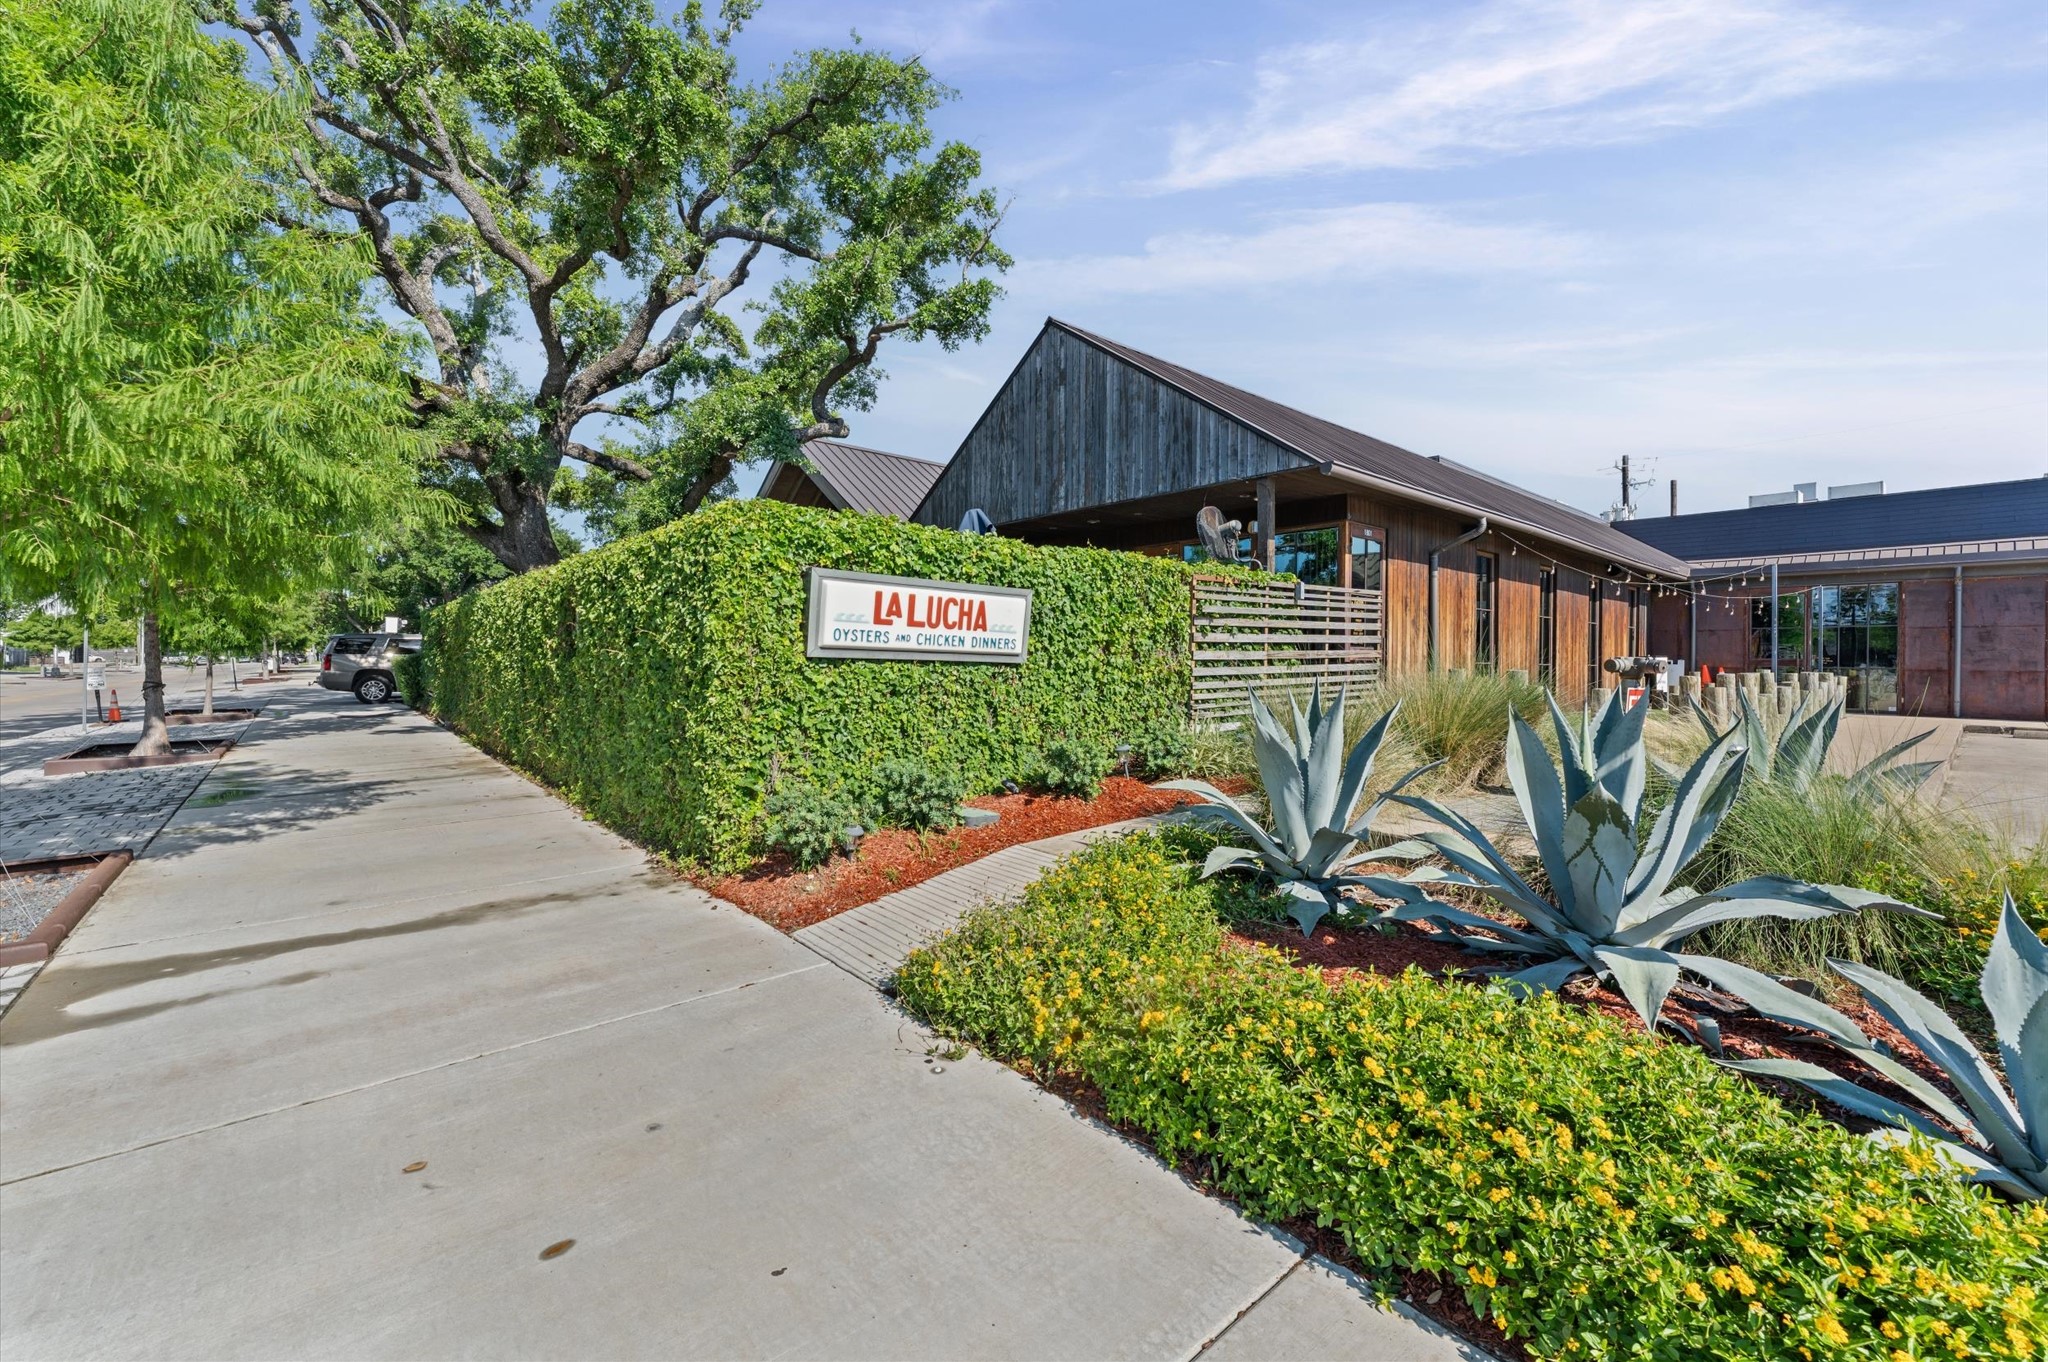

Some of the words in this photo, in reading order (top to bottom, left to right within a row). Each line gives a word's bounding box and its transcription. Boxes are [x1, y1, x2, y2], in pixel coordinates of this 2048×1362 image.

[873, 590, 903, 626] LA
[906, 593, 988, 632] LUCHA
[833, 627, 890, 644] OYSTERS
[895, 634, 911, 643] AND
[916, 632, 965, 648] CHICKEN
[971, 636, 1017, 650] DINNERS
